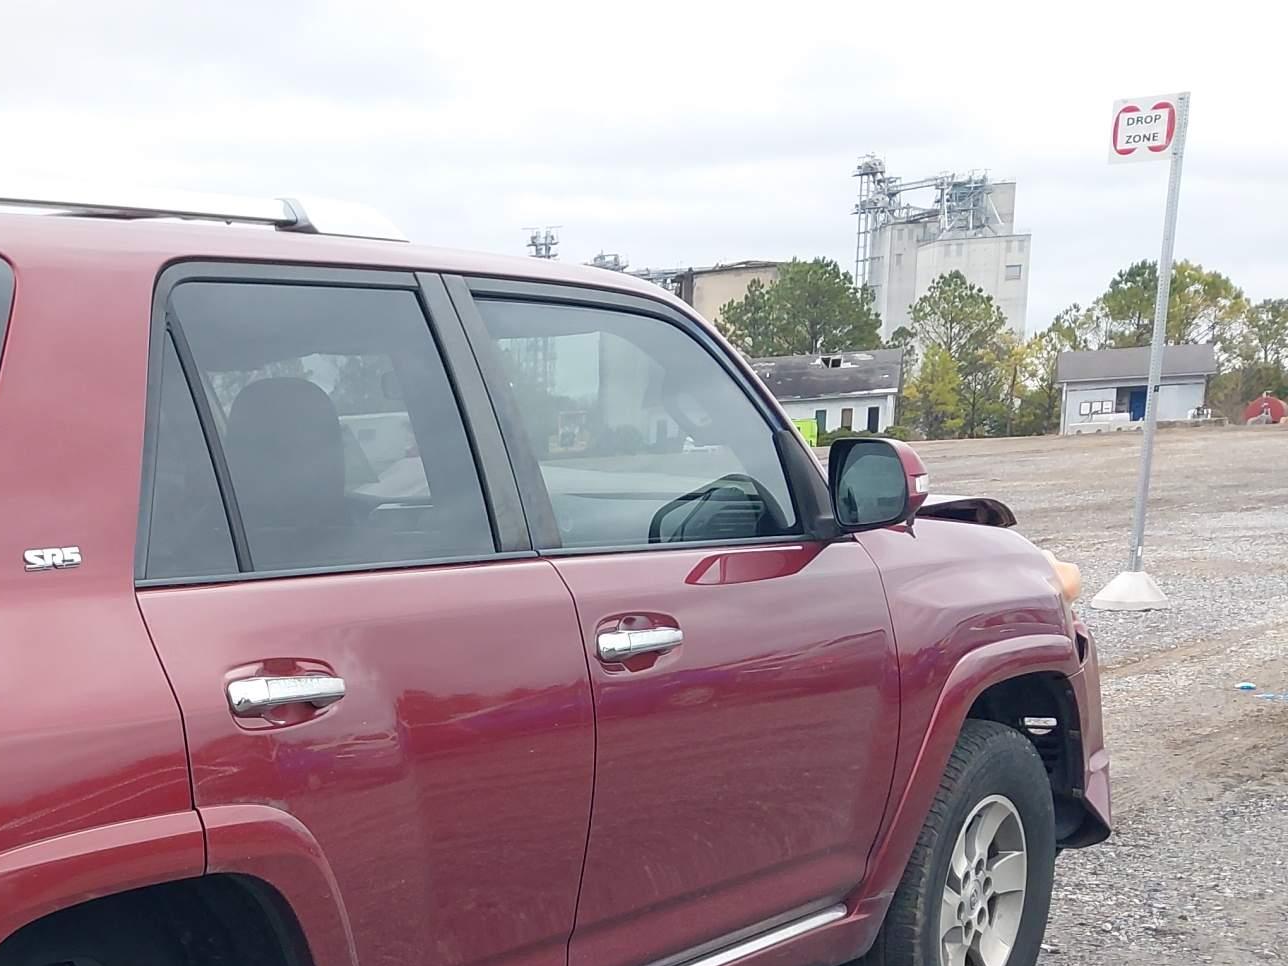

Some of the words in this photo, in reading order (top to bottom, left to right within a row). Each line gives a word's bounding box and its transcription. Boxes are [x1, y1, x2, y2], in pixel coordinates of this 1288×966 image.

[1126, 114, 1162, 126] DROP
[1125, 132, 1159, 145] ZONE
[23, 546, 82, 572] SR5
